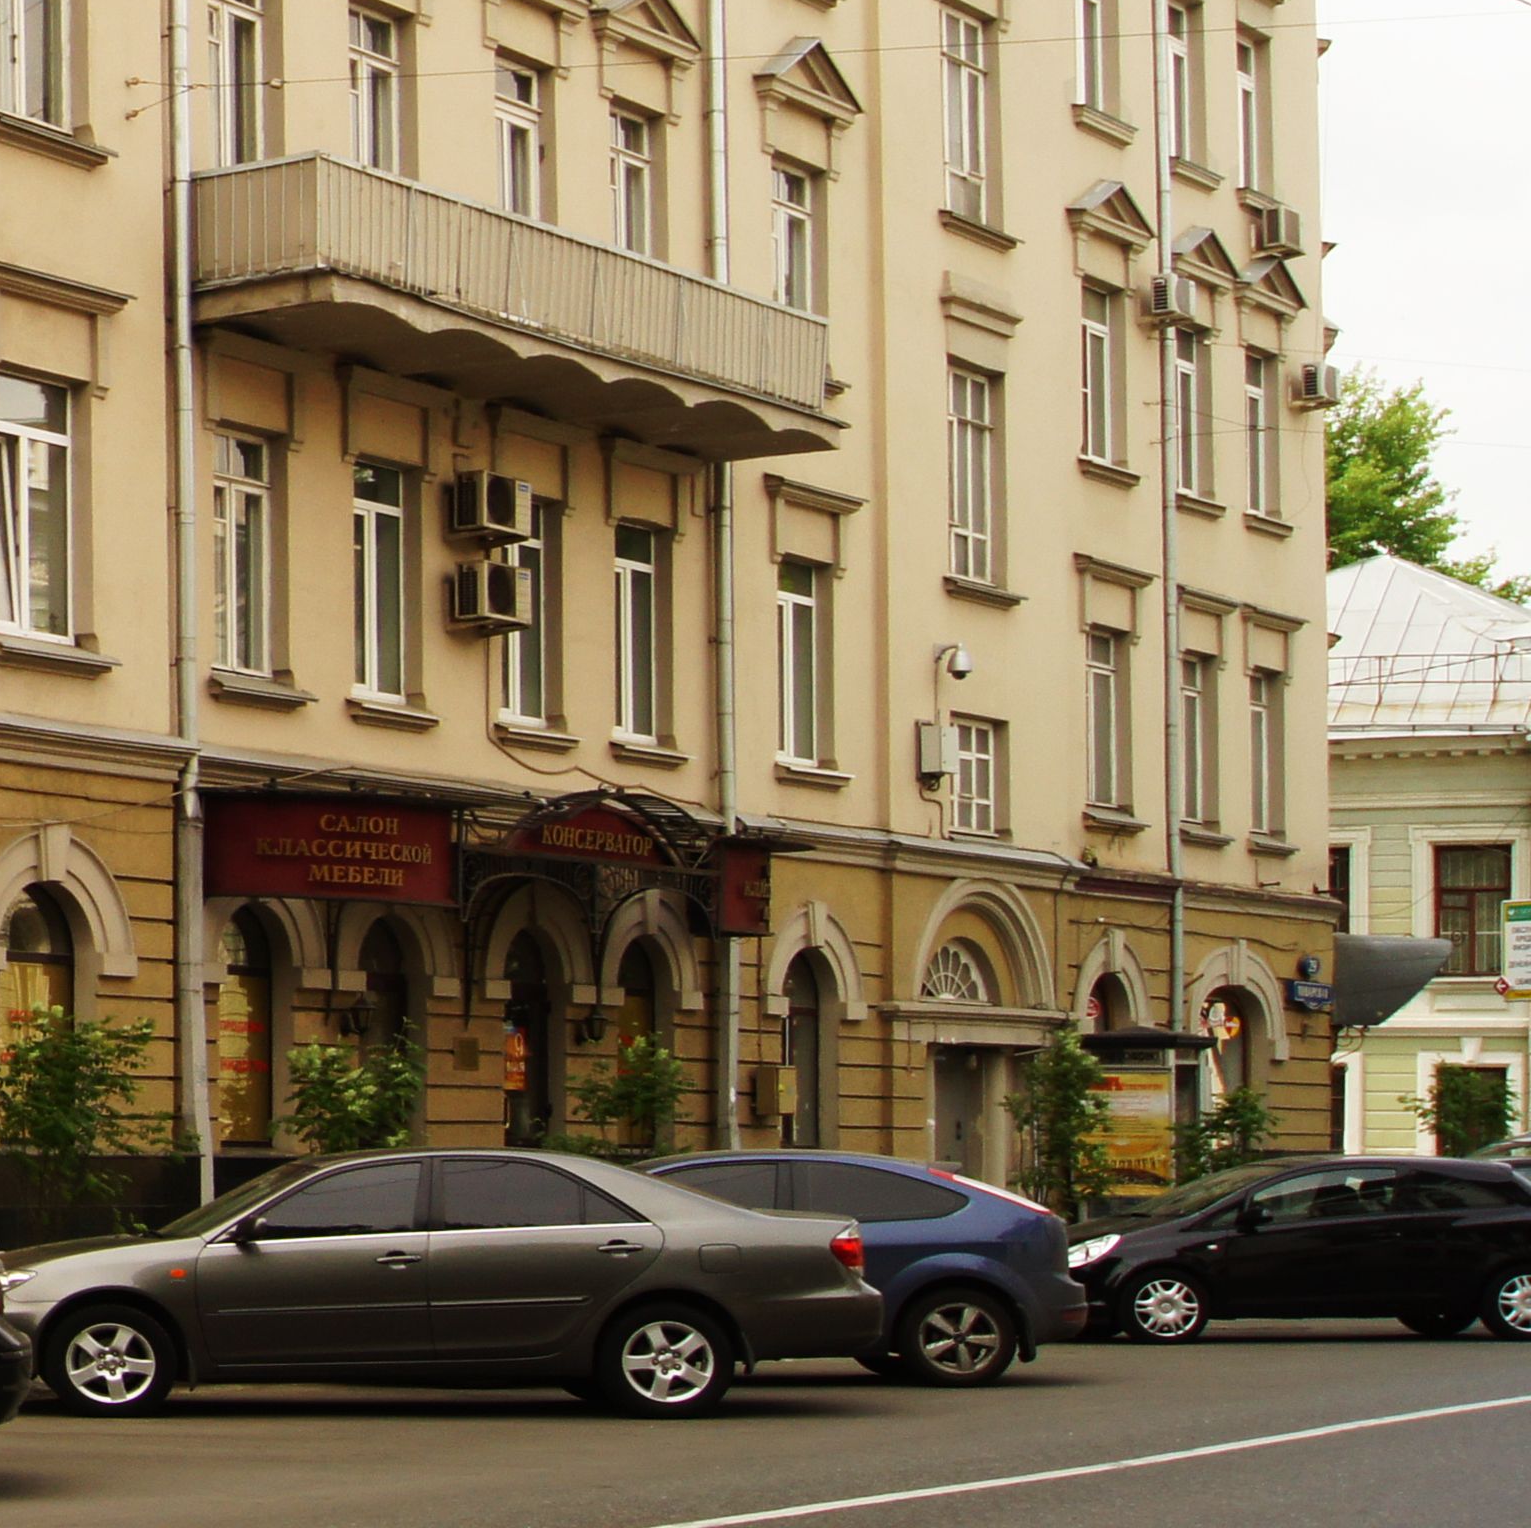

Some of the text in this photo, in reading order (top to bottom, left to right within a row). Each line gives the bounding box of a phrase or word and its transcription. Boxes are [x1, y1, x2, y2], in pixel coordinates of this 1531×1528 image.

[319, 813, 399, 836] САЛОН
[255, 837, 432, 865] КЛАССИЧЕСКОЙ
[541, 824, 653, 857] КОНСЕРВАТОР
[307, 864, 404, 887] МЕБЕЛИ
